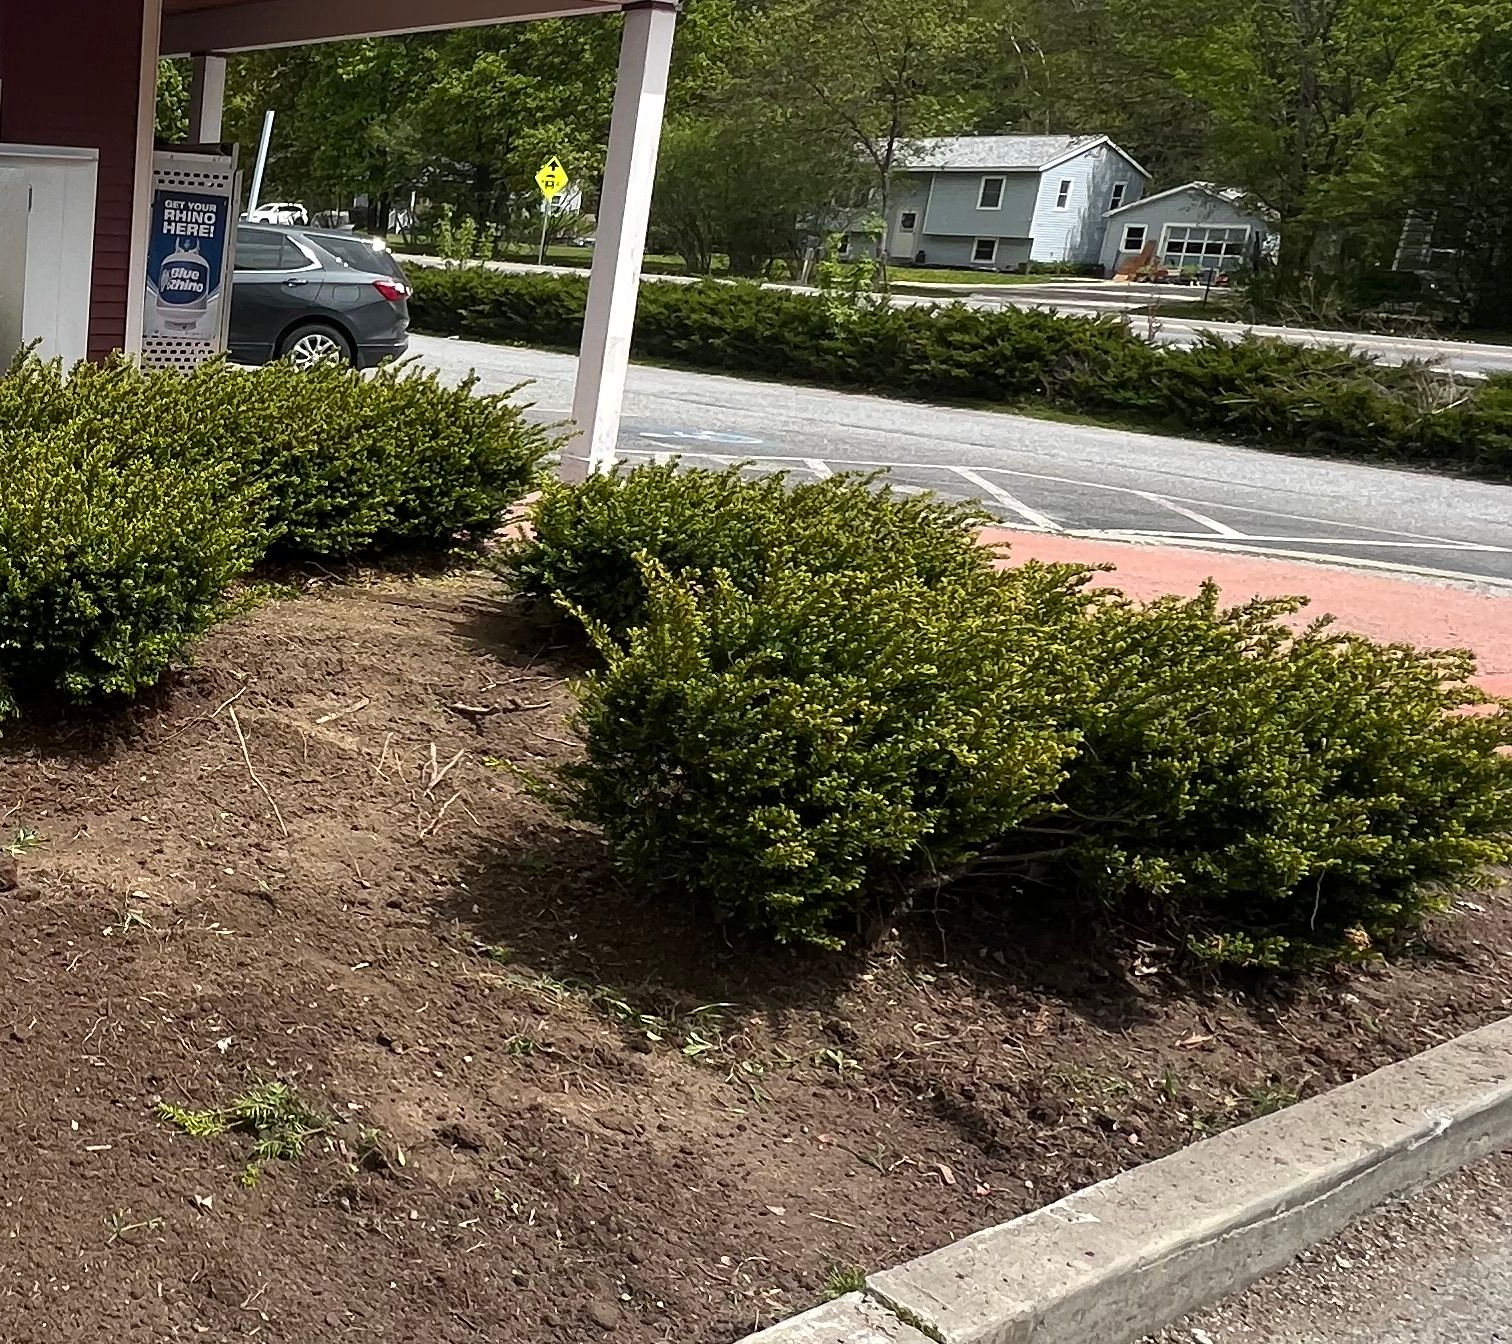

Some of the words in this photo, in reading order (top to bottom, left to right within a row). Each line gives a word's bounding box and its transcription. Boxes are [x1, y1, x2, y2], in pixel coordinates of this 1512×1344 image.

[164, 199, 186, 210] GET
[188, 201, 217, 213] YOUR
[163, 209, 216, 224] RHINO
[162, 221, 215, 238] HERE!
[170, 267, 200, 281] Blue
[166, 278, 204, 293] Rhino
